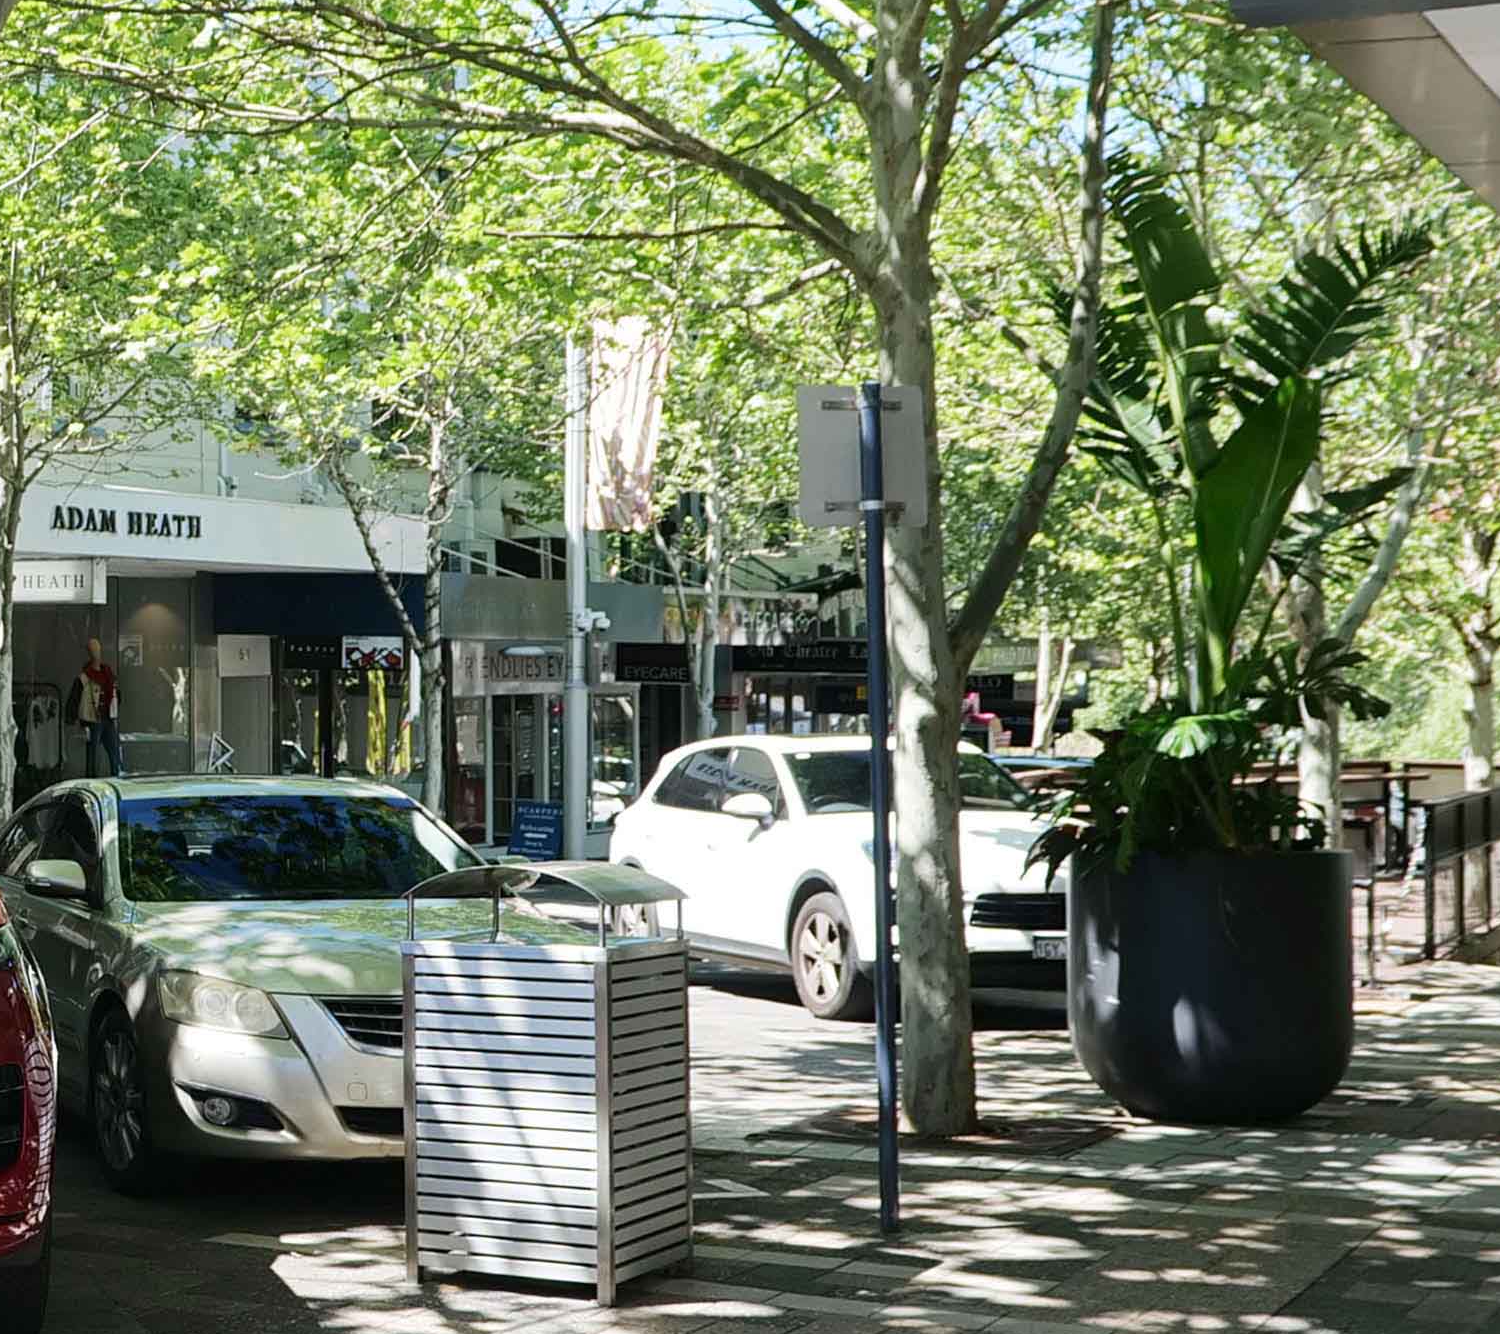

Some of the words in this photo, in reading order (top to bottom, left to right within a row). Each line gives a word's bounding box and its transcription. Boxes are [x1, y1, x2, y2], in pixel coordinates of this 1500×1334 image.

[51, 504, 117, 534] ADAM
[126, 511, 202, 539] HEATH
[22, 573, 85, 589] HEATH
[624, 666, 689, 681] EYECARE
